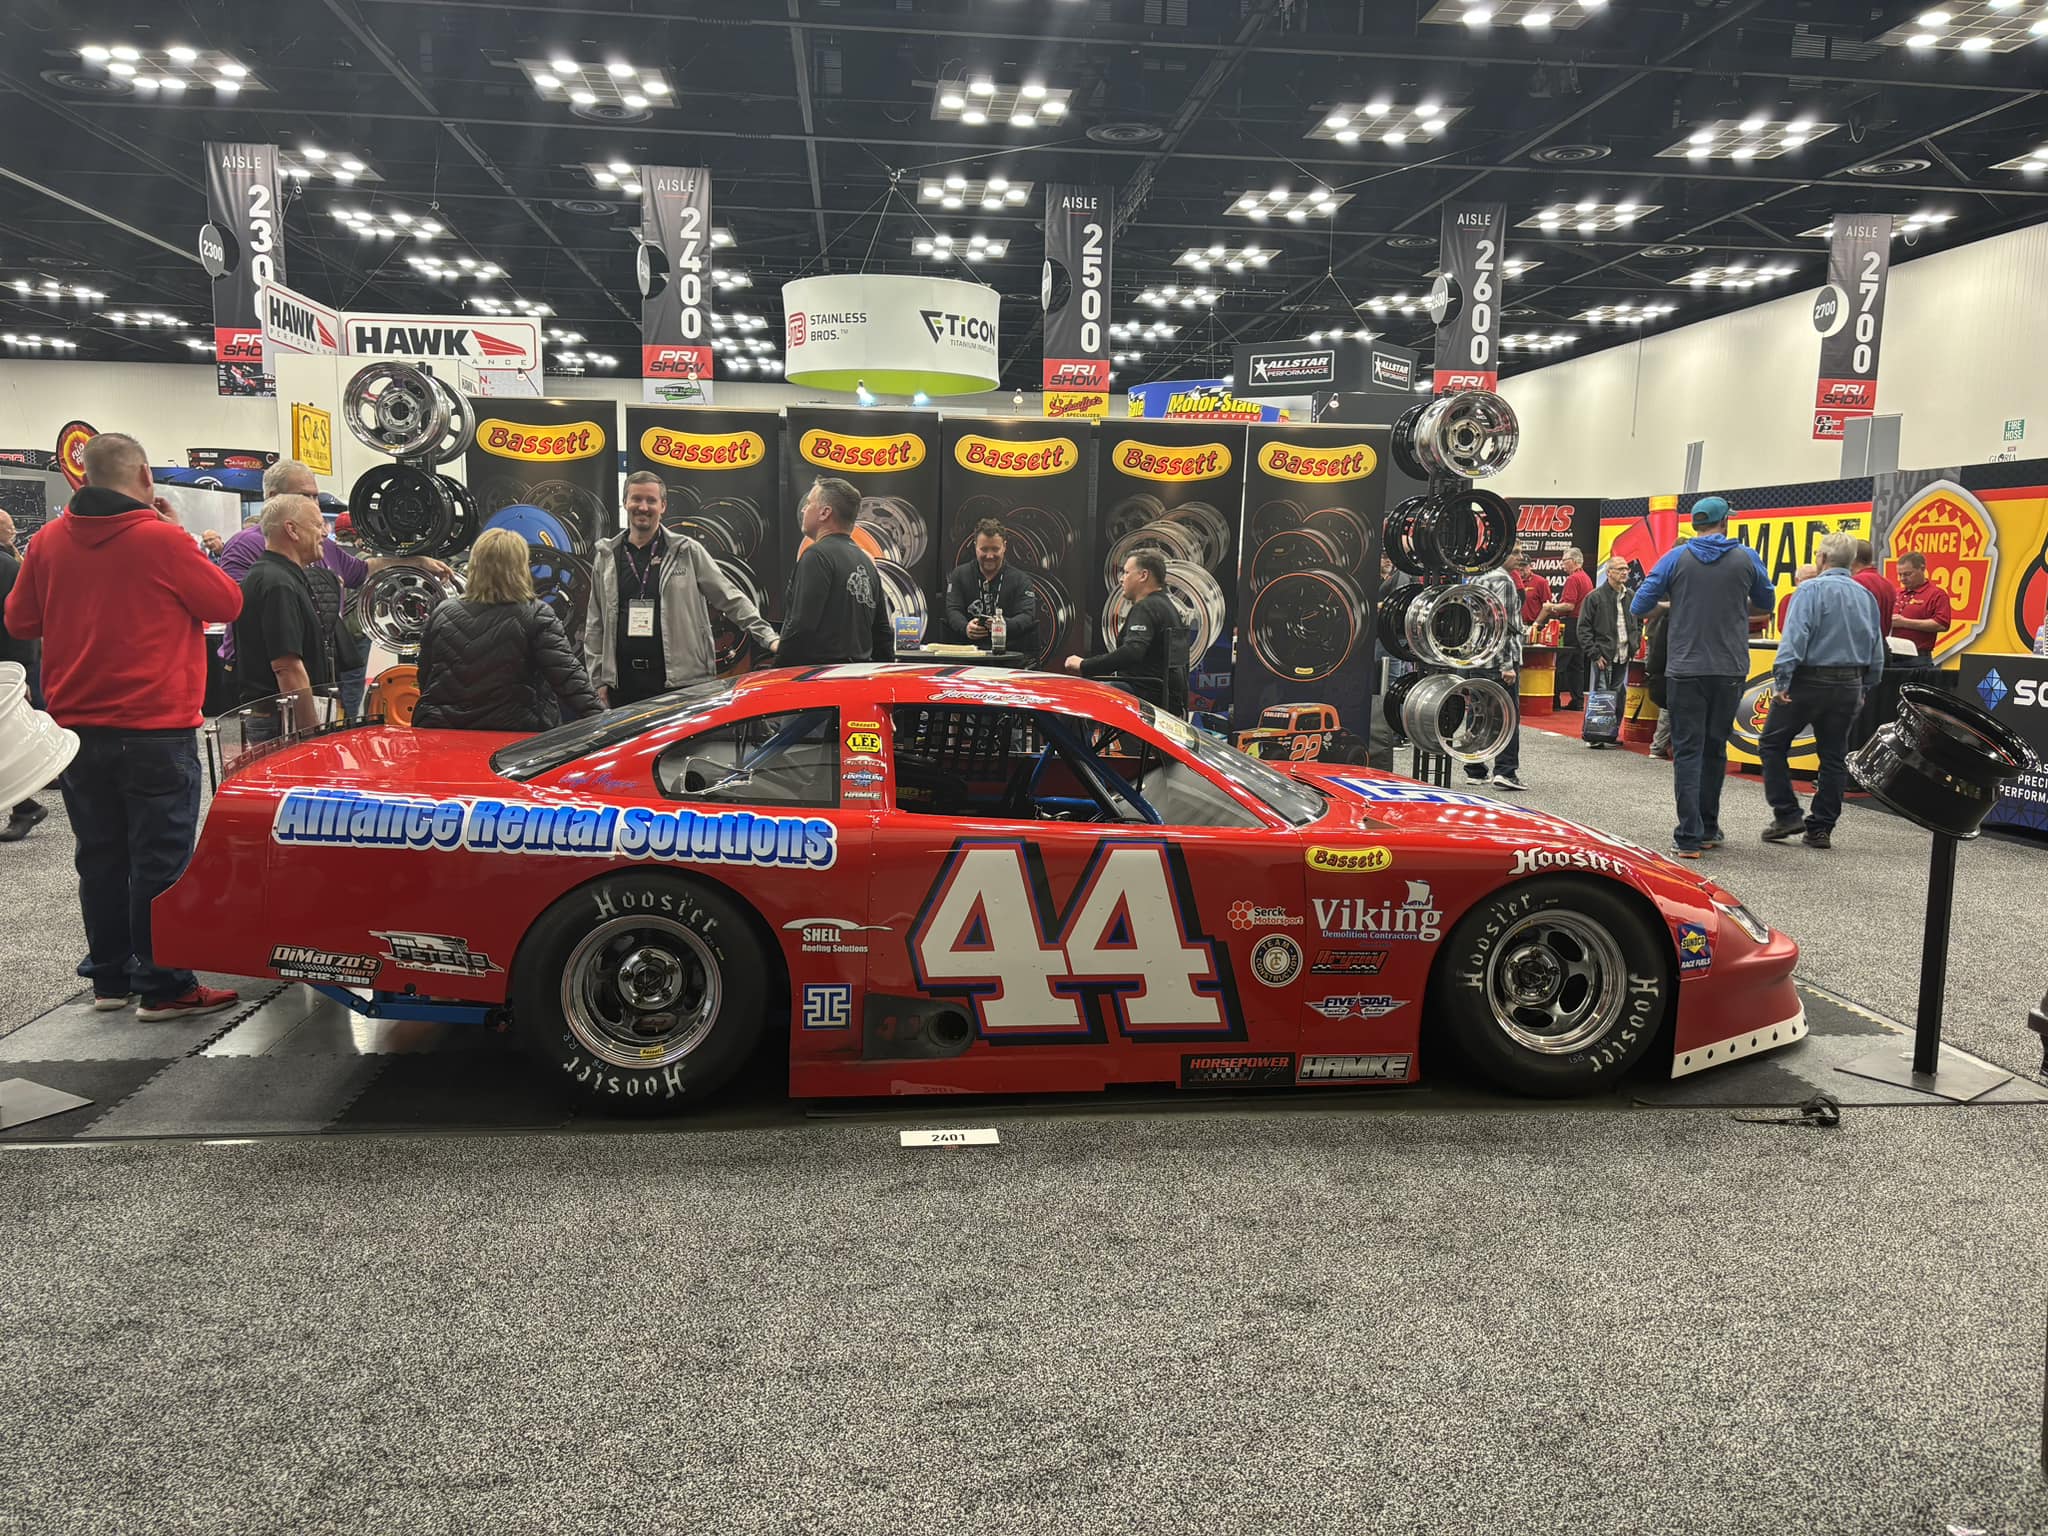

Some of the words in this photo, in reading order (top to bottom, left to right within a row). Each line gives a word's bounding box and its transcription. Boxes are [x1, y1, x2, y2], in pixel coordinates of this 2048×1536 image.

[222, 155, 262, 169] AISLE
[657, 178, 695, 193] AISLE
[1062, 196, 1098, 210] AISLE
[1457, 214, 1491, 226] AISLE
[1846, 225, 1878, 238] AISLE
[202, 239, 223, 262] 2300
[679, 207, 702, 339] 2400
[1080, 223, 1102, 353] 2500
[1470, 239, 1495, 365] 2600
[1814, 301, 1836, 319] 2700
[1852, 251, 1881, 374] 2700
[269, 295, 317, 342] HAWK
[810, 312, 867, 325] STAINLESS
[355, 326, 471, 356] HAWK
[659, 350, 698, 362] PRI
[1267, 357, 1330, 369] ALLSTAR
[1058, 364, 1097, 376] PRI
[1267, 367, 1329, 377] PERFORMANCE
[1381, 360, 1409, 374] ALLSTAR
[1050, 375, 1102, 386] SHOW
[1448, 376, 1485, 387] PRI
[1830, 384, 1865, 395] PRI
[1822, 394, 1870, 405] SHOW
[2007, 420, 2023, 431] FIRE
[487, 427, 591, 455] Bassett
[2004, 430, 2023, 440] HOSE
[655, 435, 750, 465] Bassett
[811, 436, 910, 467] Bassett
[966, 443, 1064, 470] Bassett
[1124, 447, 1217, 476] Bassett
[1269, 448, 1362, 477] Bassett
[1915, 532, 1958, 553] SINCE
[1737, 518, 1861, 587] MAD
[852, 737, 878, 748] LEE
[1289, 733, 1322, 762] 22
[2017, 774, 2048, 788] PRECI
[1999, 784, 2048, 804] PERFORM
[277, 789, 465, 847] Alliance
[467, 800, 621, 854] Rental
[620, 807, 834, 866] Solutions
[1313, 849, 1385, 868] Bassett
[1508, 846, 1626, 876] Hoosier
[593, 886, 719, 932] Hoosier
[1254, 907, 1286, 917] Serck
[1254, 917, 1303, 927] Motorsport
[1312, 898, 1443, 942] Viking
[802, 928, 841, 942] SHELL
[919, 848, 1222, 1027] 44
[1322, 930, 1368, 940] Demolition
[1370, 930, 1418, 941] Contractors
[1681, 935, 1706, 950] SUNOCO
[833, 944, 868, 953] Solutions
[1262, 939, 1291, 951] TEAM
[273, 947, 378, 970] DiMarzo's
[395, 945, 486, 967] PETERS
[1681, 960, 1695, 968] RACE
[1695, 957, 1711, 967] FUELS
[1324, 996, 1357, 1007] FIVE
[1360, 996, 1392, 1007] STAR
[1190, 1056, 1289, 1069] HORSEPOWER
[1300, 1056, 1408, 1079] HAMKE
[931, 1133, 966, 1142] 2401
